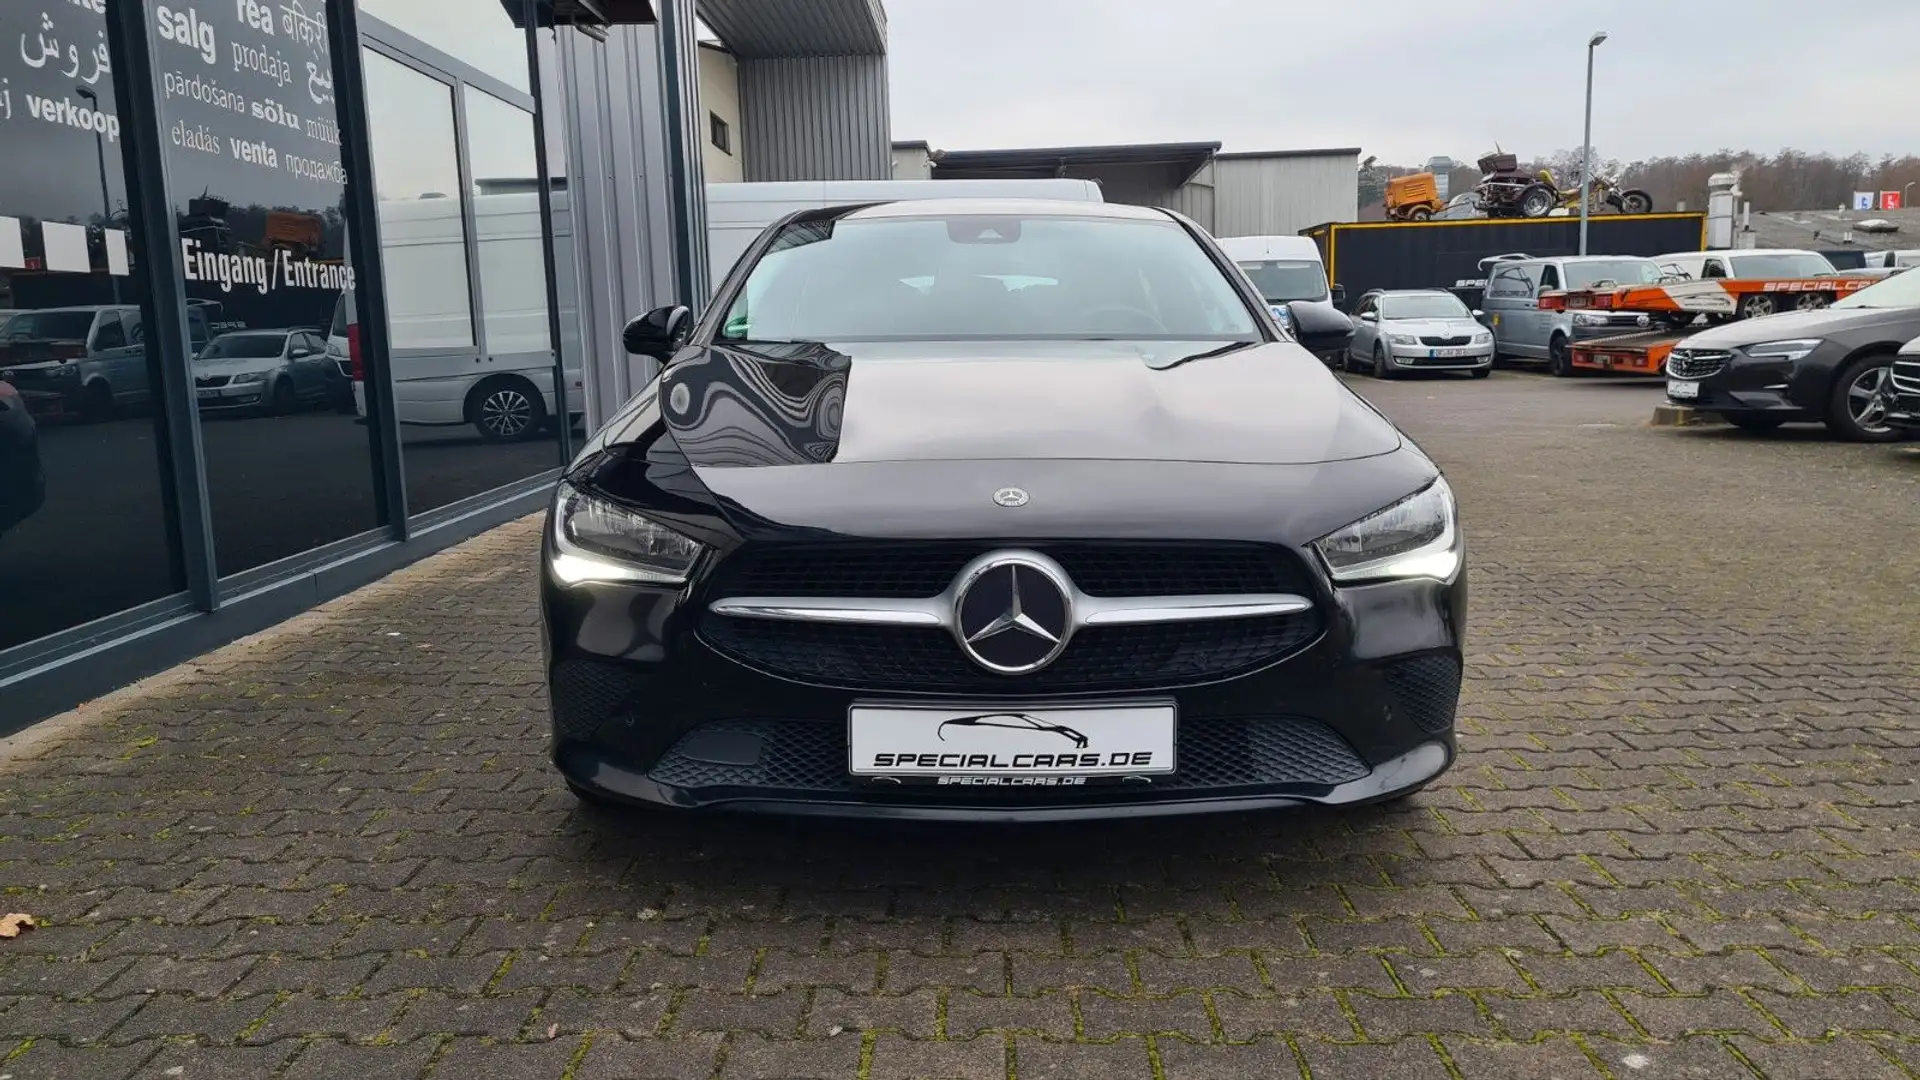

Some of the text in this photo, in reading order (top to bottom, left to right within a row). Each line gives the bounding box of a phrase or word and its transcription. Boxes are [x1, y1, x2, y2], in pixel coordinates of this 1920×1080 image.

[236, 0, 275, 36] rea
[157, 5, 292, 87] salg prodaja
[26, 94, 120, 142] verkoop
[164, 70, 245, 113] pārdošana
[251, 98, 301, 130] sölu
[172, 119, 278, 169] eladás venta
[286, 153, 348, 185] продажба
[181, 238, 268, 295] Eingang
[282, 250, 356, 290] Entrance
[874, 751, 1153, 768] SPECIALCARS.DE
[937, 775, 1087, 787] SPECIALCARS.DE
